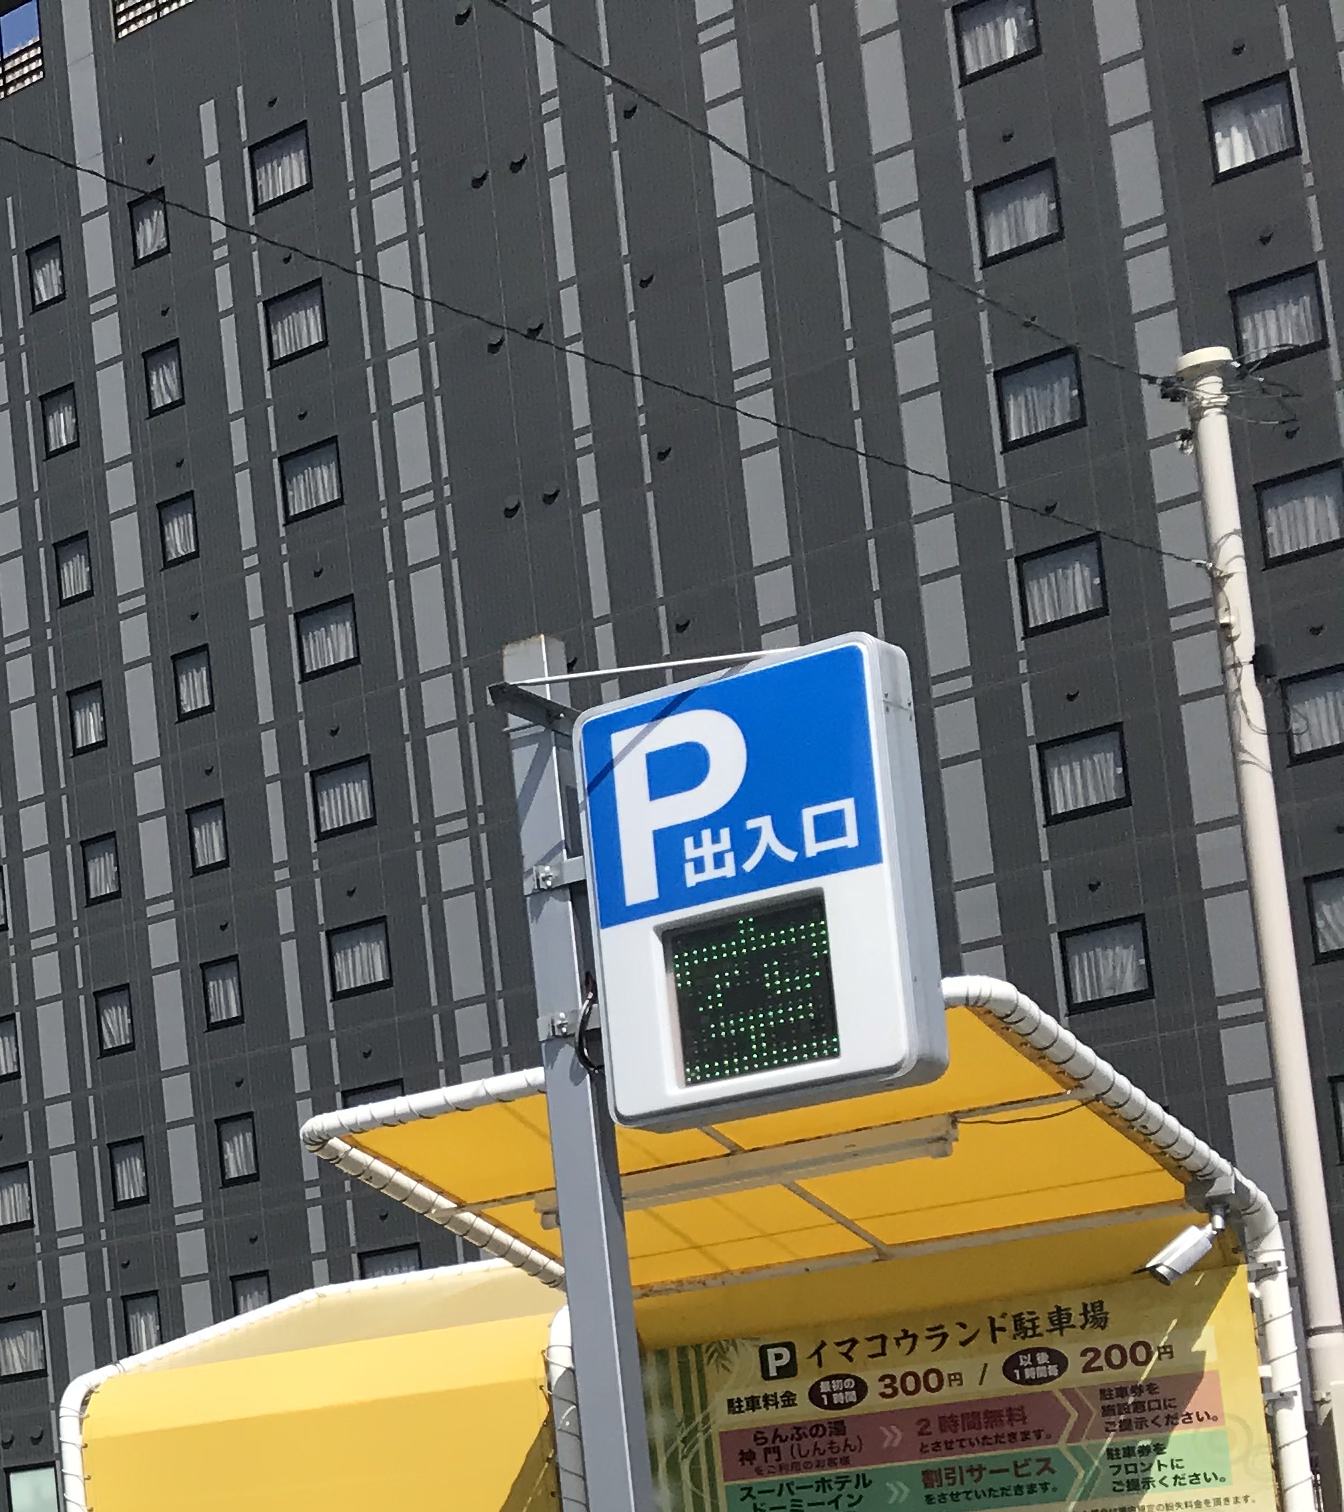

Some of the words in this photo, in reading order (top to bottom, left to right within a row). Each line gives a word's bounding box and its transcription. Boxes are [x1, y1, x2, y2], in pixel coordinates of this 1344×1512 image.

[611, 709, 747, 906] P
[684, 798, 859, 887] 出入口
[806, 1299, 1110, 1369] イマコウランド駐車場
[1019, 1352, 1049, 1366] 以後
[1080, 1340, 1174, 1374] 200円
[820, 1378, 855, 1393] 最初の
[878, 1367, 963, 1400] 300円
[727, 1390, 798, 1415] 駐車料金
[821, 1391, 857, 1406] 1時間
[916, 1405, 1028, 1437] 2時間無料
[1104, 1410, 1218, 1433] ご提示ください。
[919, 1428, 1052, 1454] とさせていただきます。
[1106, 1443, 1166, 1461] 駐車券を
[921, 1457, 1057, 1490] 割引サービス
[1109, 1458, 1184, 1476] フロントに
[740, 1473, 872, 1502] スーパーホテル
[925, 1482, 1058, 1505] をさせていただきます。
[1112, 1472, 1226, 1493] ご提示ください。
